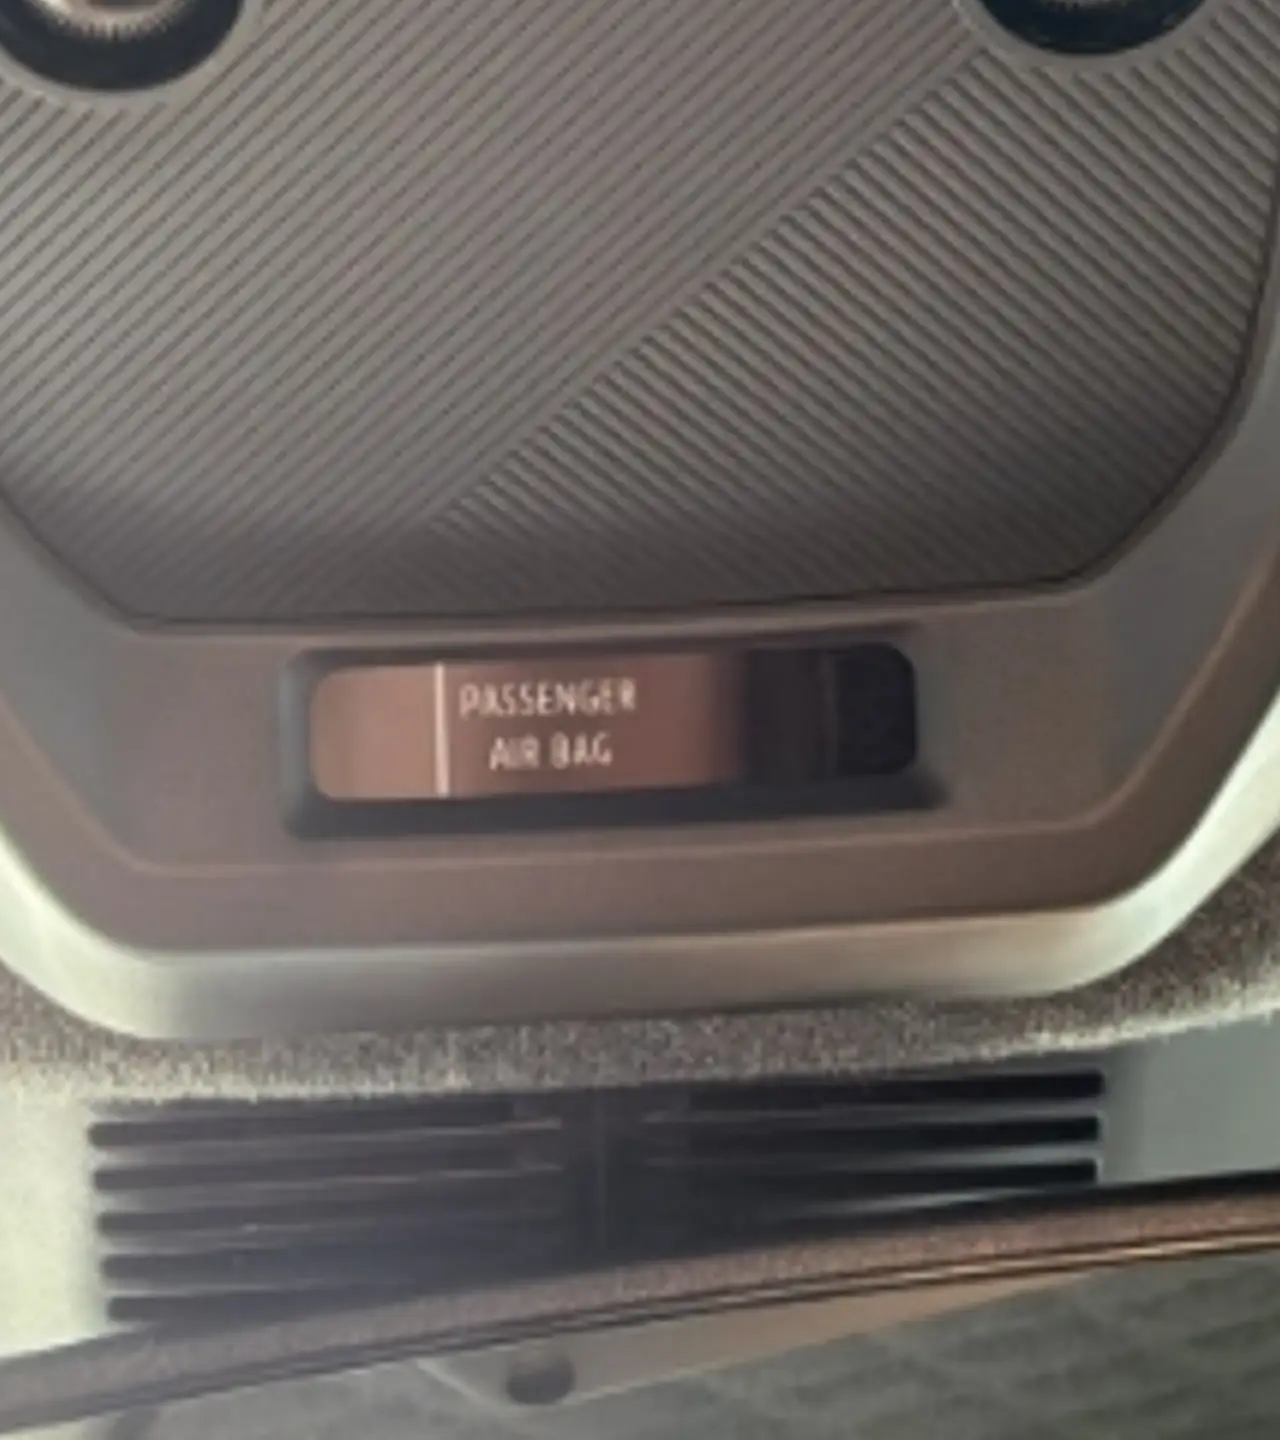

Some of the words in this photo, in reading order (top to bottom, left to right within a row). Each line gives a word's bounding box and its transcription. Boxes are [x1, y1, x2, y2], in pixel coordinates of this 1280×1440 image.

[459, 677, 635, 717] PASSENGER
[489, 735, 540, 770] AIR
[550, 730, 613, 769] BAG
